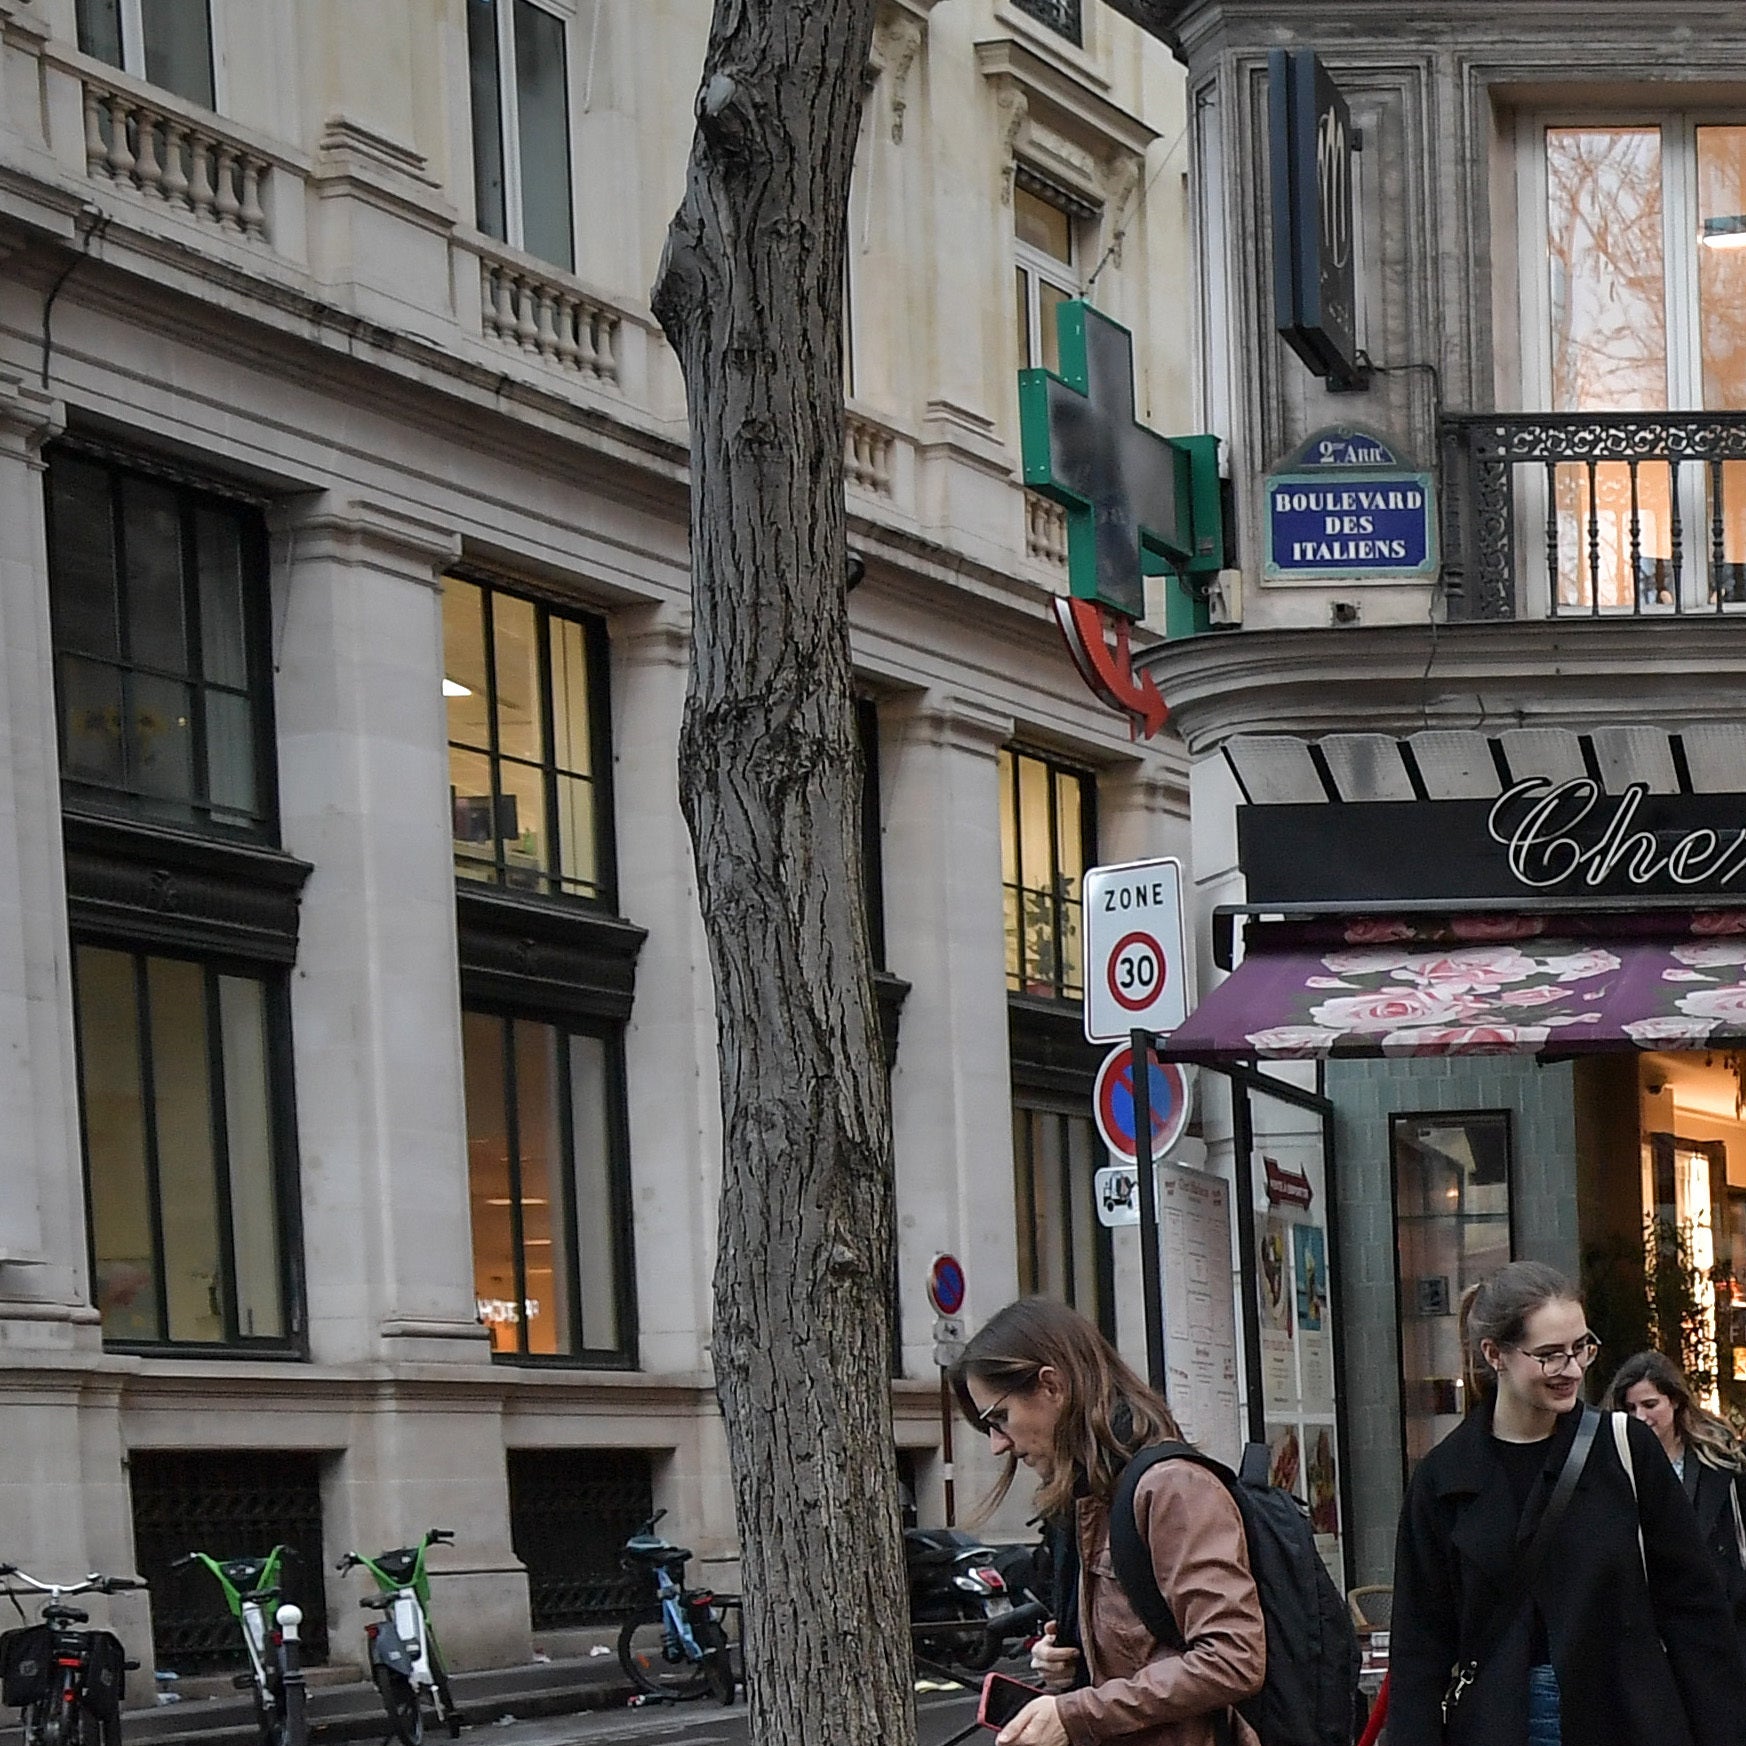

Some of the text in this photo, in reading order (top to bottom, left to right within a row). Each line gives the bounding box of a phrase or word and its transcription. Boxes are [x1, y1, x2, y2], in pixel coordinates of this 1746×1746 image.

[1275, 490, 1422, 512] BOULEVARD
[1325, 515, 1374, 535] DES
[1293, 539, 1406, 561] ITALIENS
[1104, 882, 1164, 913] ZONE
[1119, 955, 1155, 989] 30
